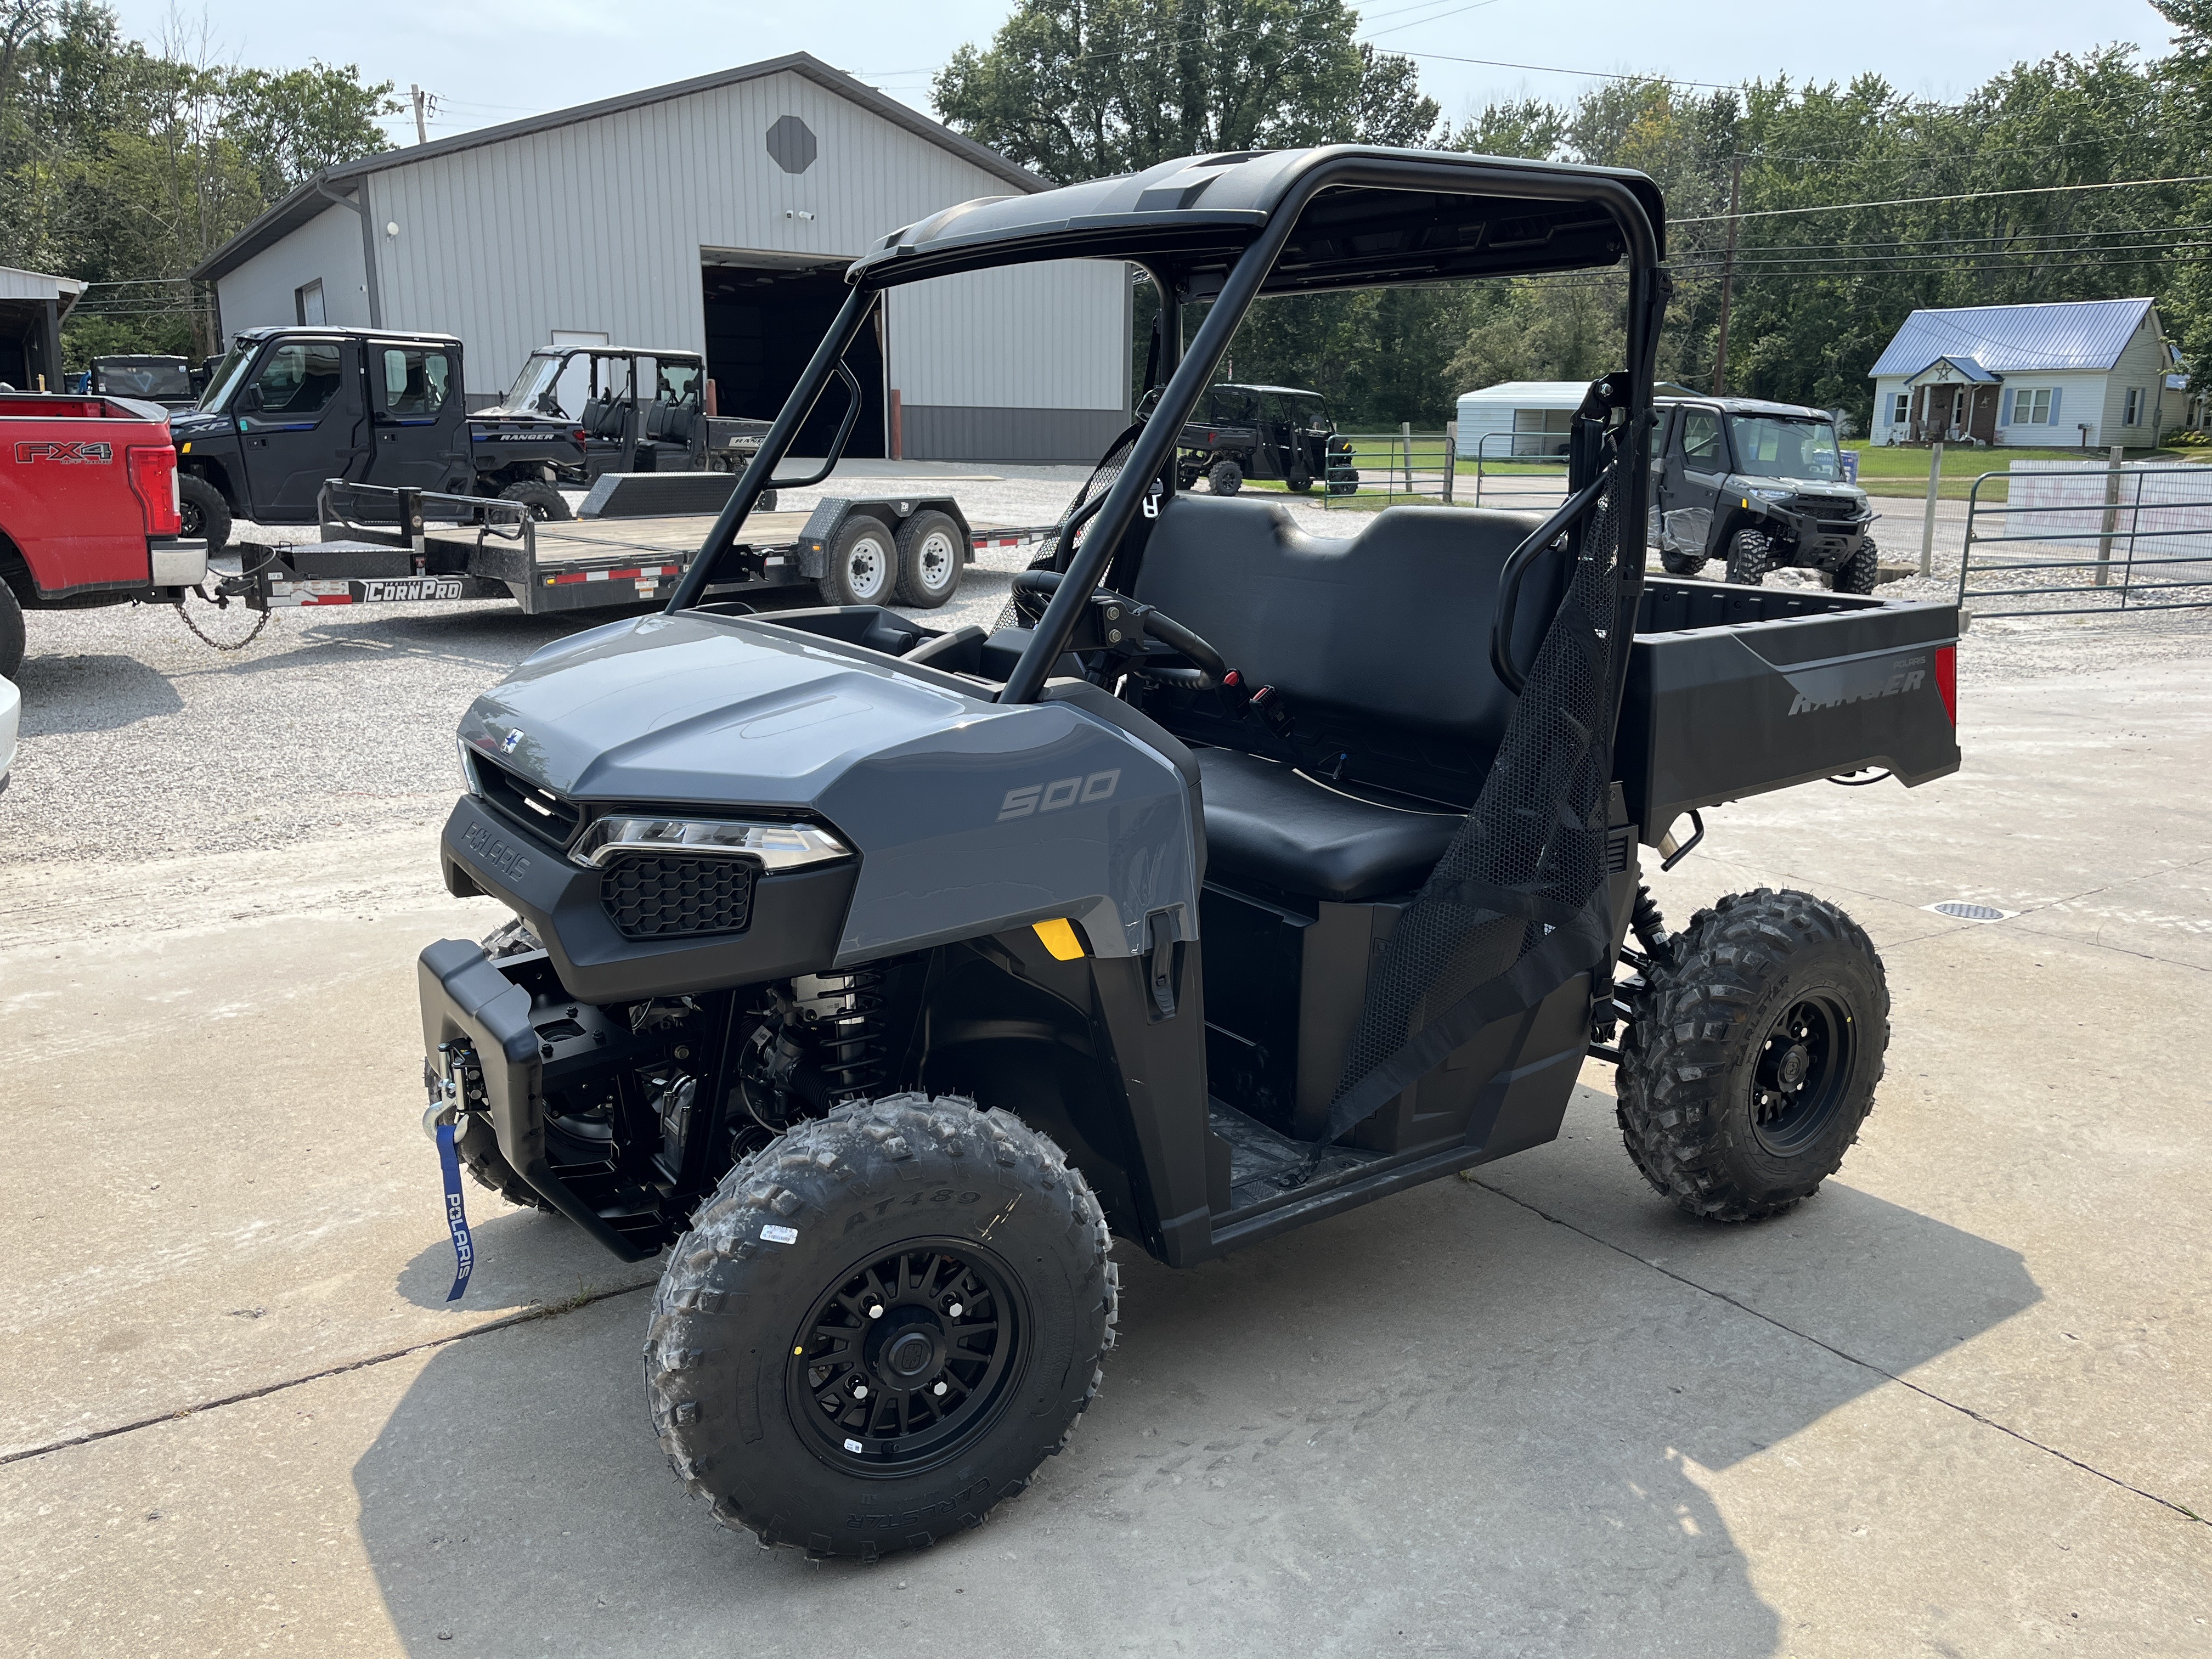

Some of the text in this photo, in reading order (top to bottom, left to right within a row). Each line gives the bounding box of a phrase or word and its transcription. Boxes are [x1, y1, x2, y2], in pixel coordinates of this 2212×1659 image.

[15, 441, 113, 463] FX4
[1894, 656, 1926, 669] POLARIS
[995, 768, 1121, 822] 500
[461, 821, 531, 882] POLARIS
[447, 1193, 471, 1280] POLARIS
[844, 1476, 991, 1531] CARLSTAR
